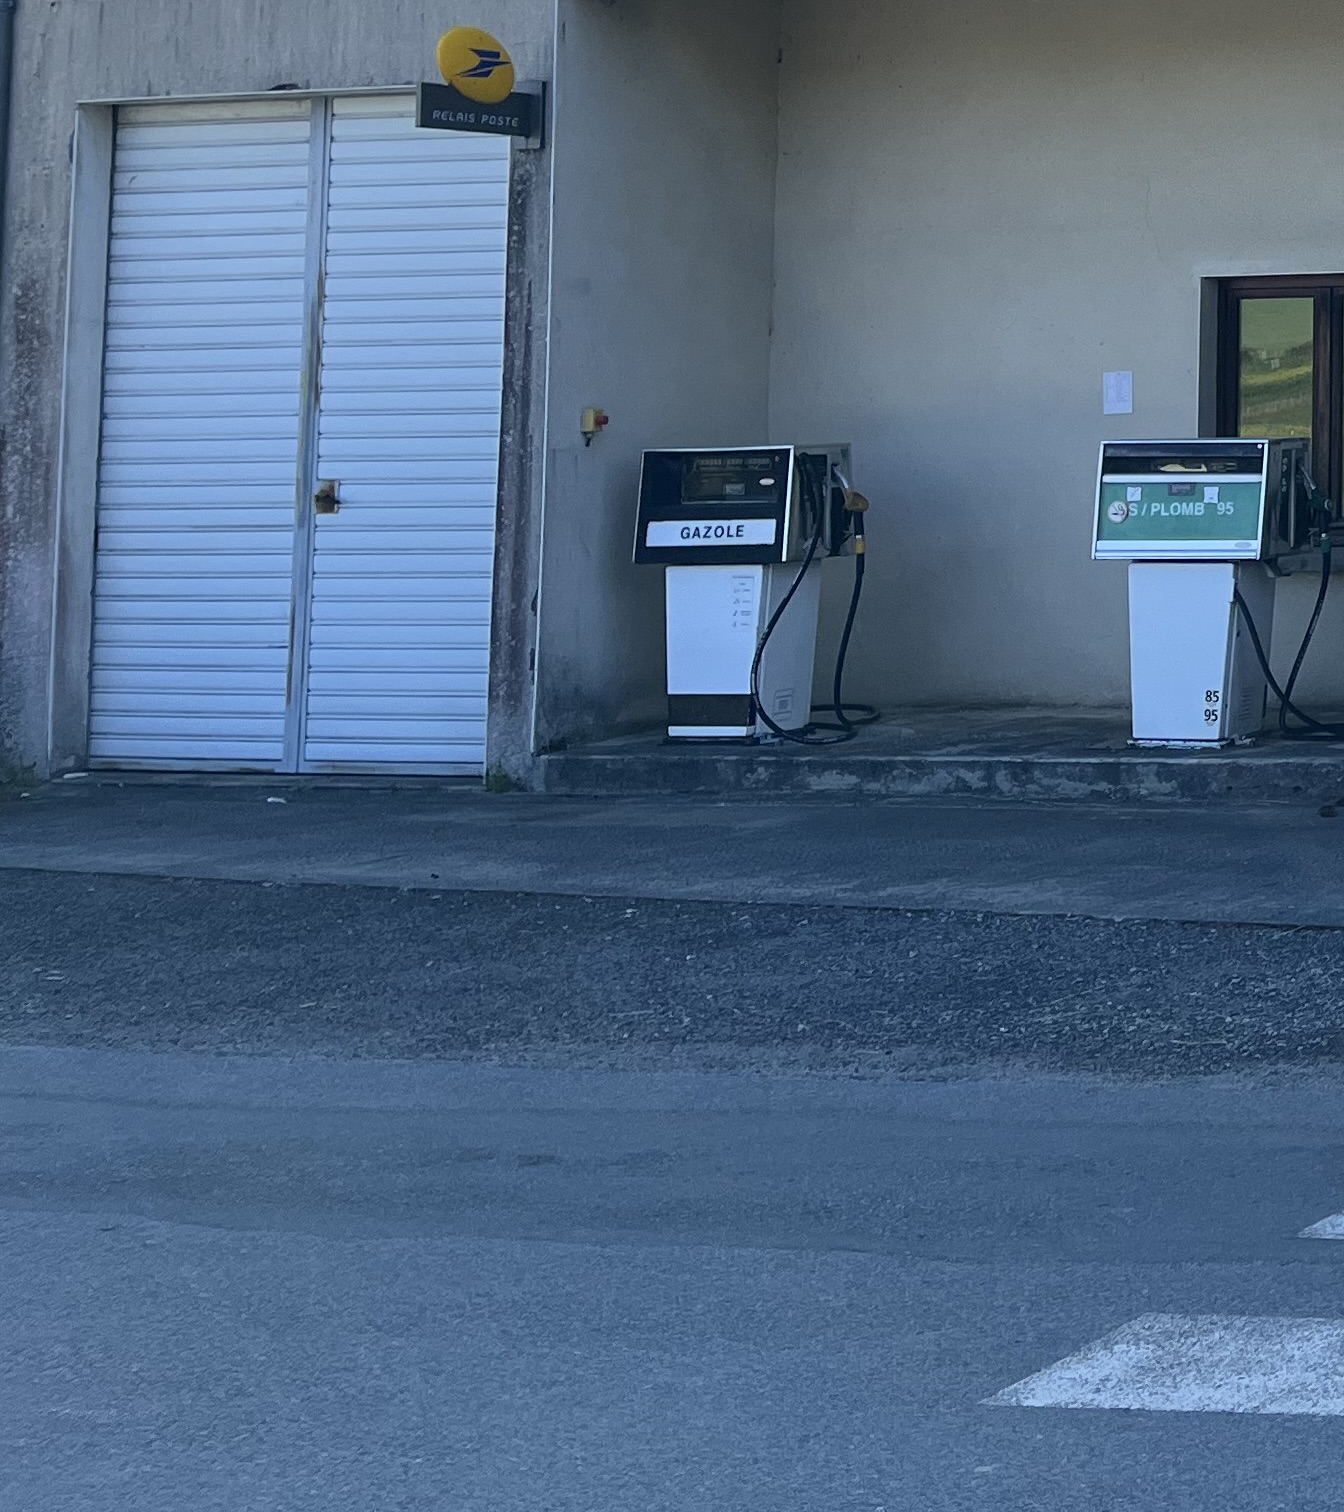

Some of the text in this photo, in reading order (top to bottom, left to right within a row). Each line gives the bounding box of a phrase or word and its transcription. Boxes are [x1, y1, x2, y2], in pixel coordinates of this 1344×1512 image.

[432, 109, 519, 127] RELAIS POSTE
[1216, 501, 1234, 515] 95
[680, 525, 745, 540] GAZOLE
[1205, 689, 1220, 703] 85
[1203, 708, 1219, 722] 95
